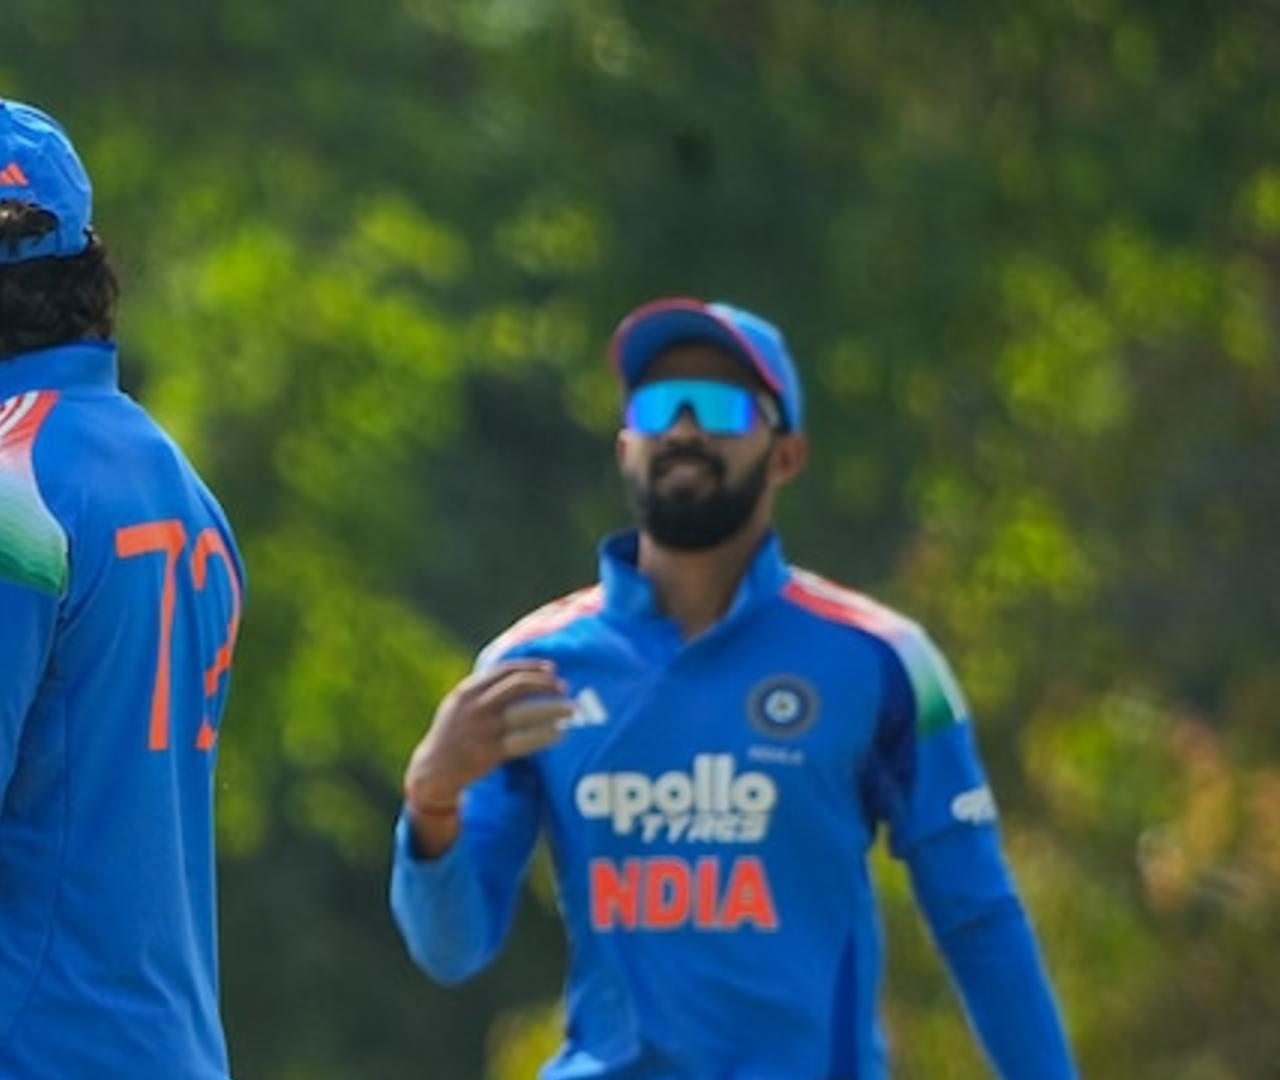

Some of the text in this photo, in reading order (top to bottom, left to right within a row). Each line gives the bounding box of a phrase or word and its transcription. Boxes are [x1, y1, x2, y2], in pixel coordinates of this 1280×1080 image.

[115, 518, 243, 752] 72
[575, 753, 778, 835] apollo
[642, 813, 770, 845] TYRES
